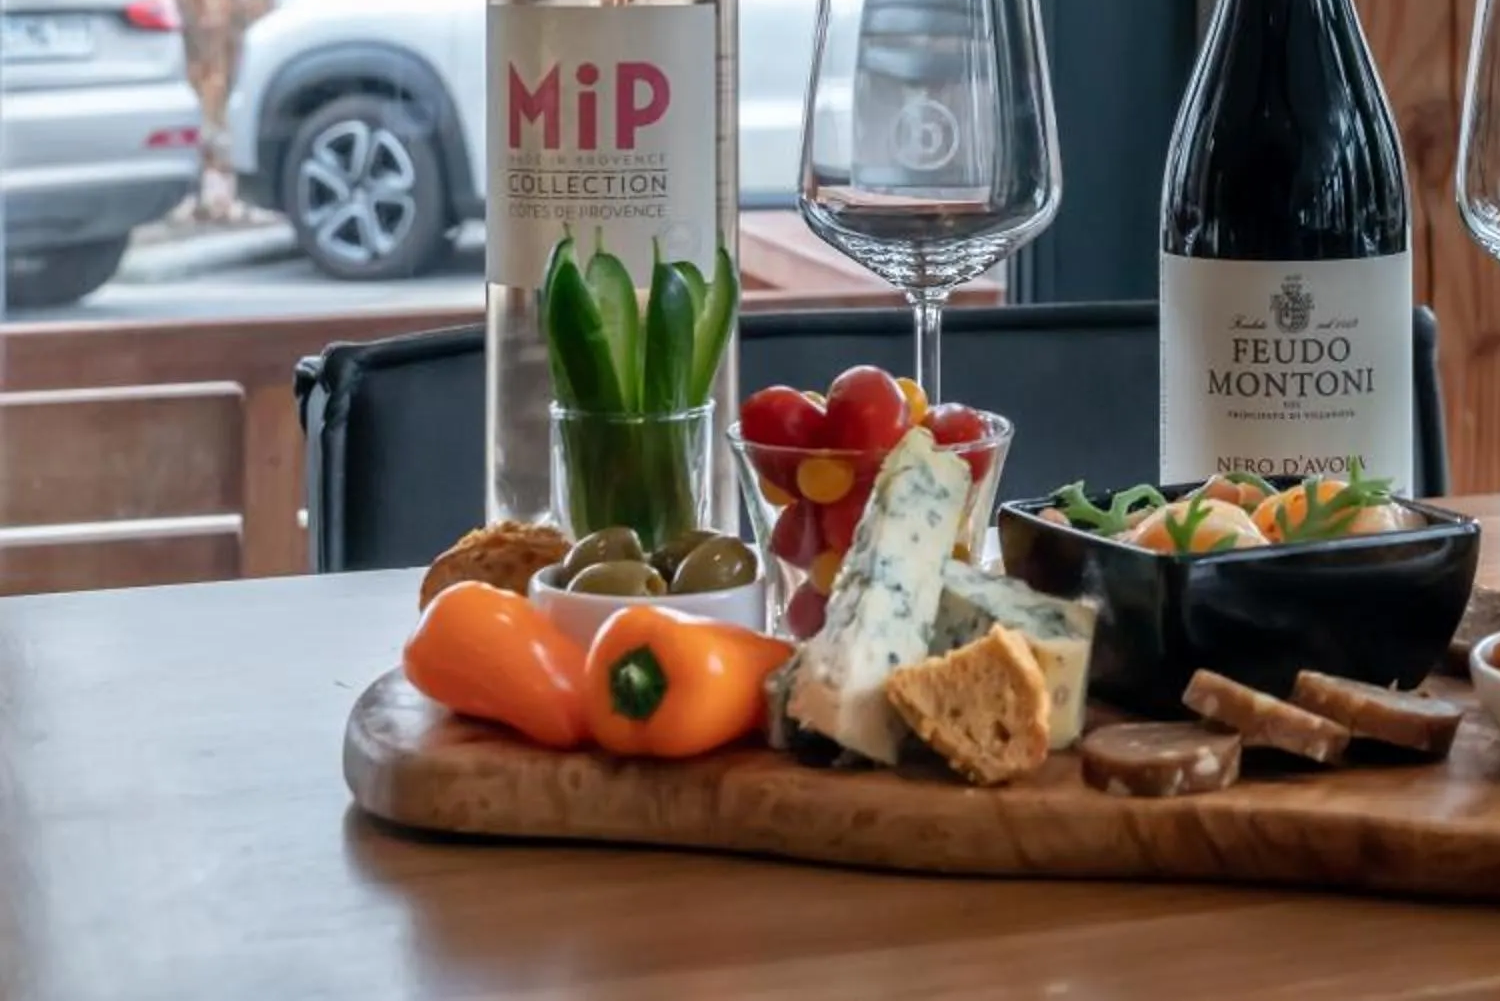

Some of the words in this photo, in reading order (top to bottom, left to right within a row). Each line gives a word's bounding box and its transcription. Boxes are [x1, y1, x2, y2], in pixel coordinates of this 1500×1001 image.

[508, 61, 671, 151] MiP
[508, 174, 667, 195] COLLECTION
[579, 203, 667, 220] PROVENCE
[1232, 336, 1351, 364] FEUDO
[1207, 367, 1375, 397] MONTONI
